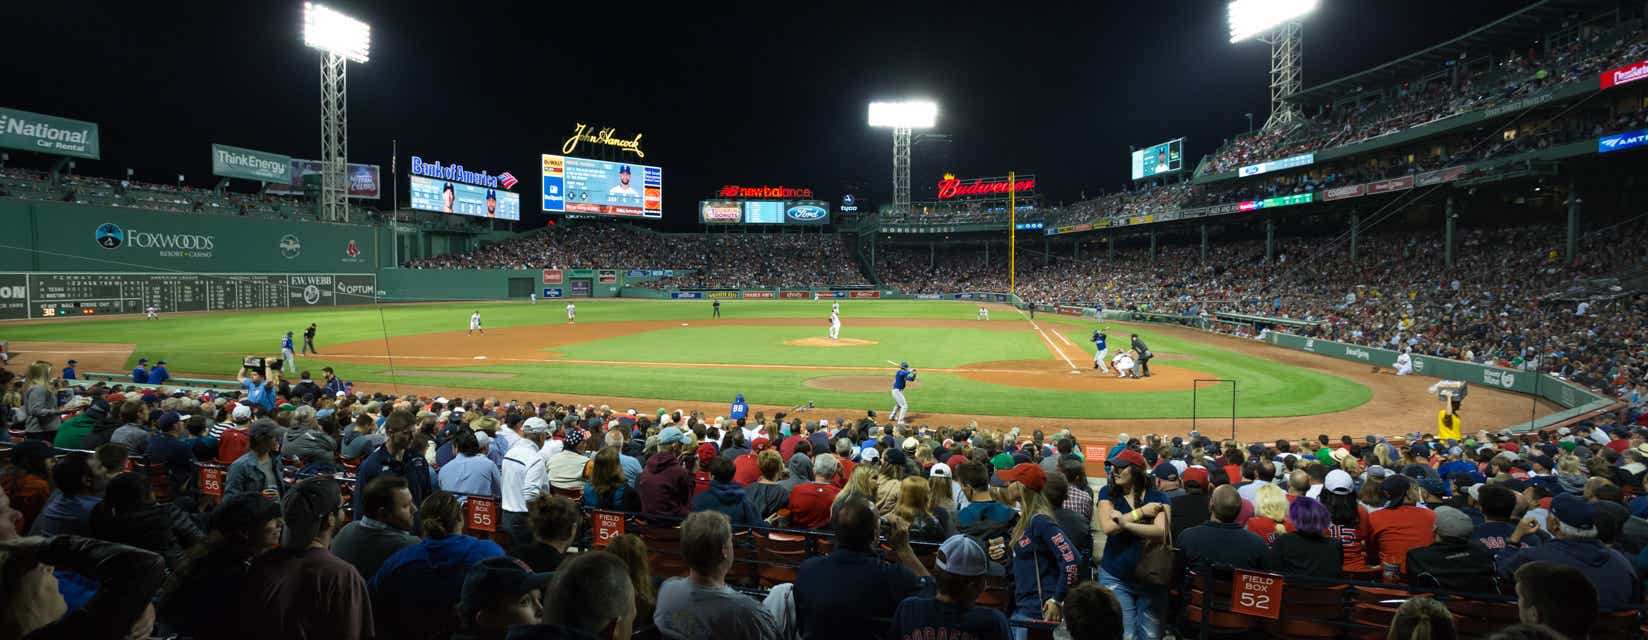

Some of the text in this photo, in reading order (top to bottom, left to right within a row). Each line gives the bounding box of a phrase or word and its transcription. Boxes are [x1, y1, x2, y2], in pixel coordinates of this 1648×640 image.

[7, 117, 88, 144] National
[37, 139, 85, 152] Car Rental
[562, 122, 645, 158] John Hancock
[411, 156, 498, 188] Bank of America
[795, 207, 819, 218] Ford
[127, 230, 214, 250] FOXWOODS
[346, 284, 374, 294] OPTUM
[205, 480, 220, 490] 56
[473, 514, 492, 526] 55
[599, 513, 620, 522] FIELD
[601, 520, 617, 528] BOX
[599, 528, 621, 541] 54
[1242, 574, 1274, 585] FIELD
[1245, 583, 1268, 593] BOX
[1239, 592, 1271, 610] 52
